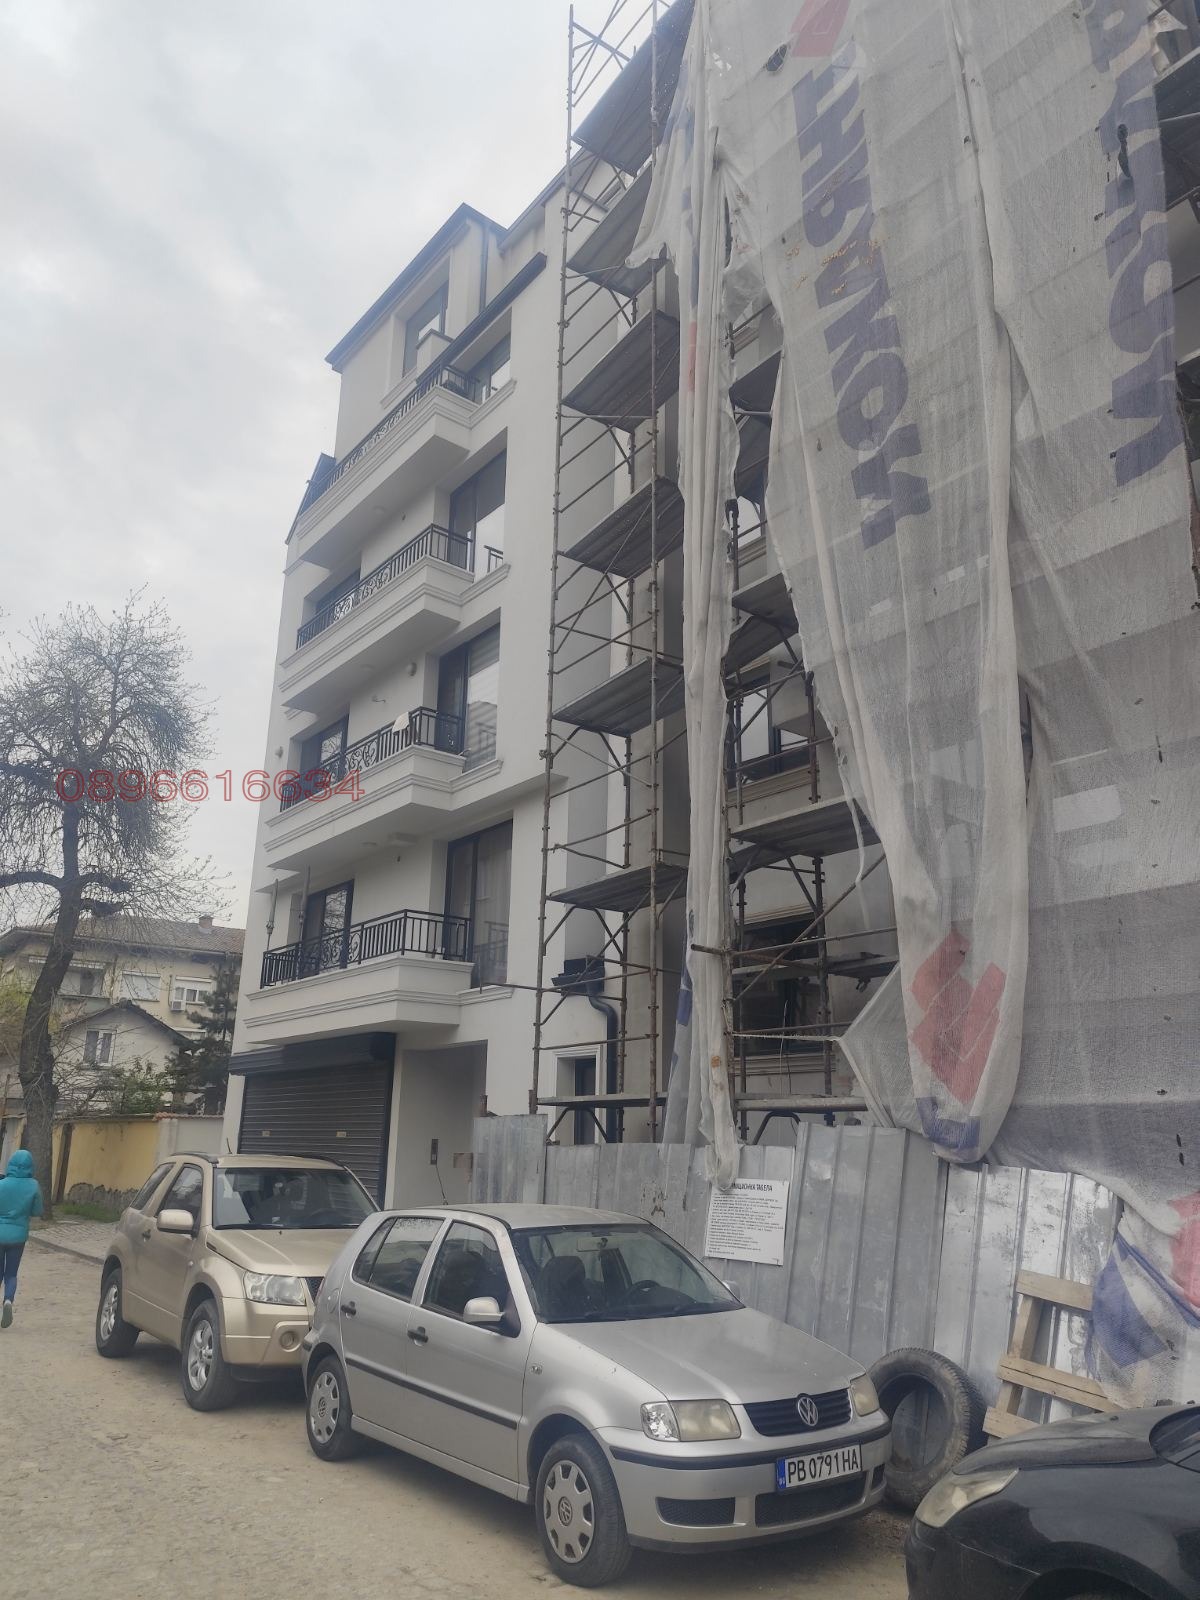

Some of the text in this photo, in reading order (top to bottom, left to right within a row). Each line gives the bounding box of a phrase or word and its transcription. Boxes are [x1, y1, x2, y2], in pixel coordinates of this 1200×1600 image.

[787, 1449, 859, 1483] PB 0791 HA
